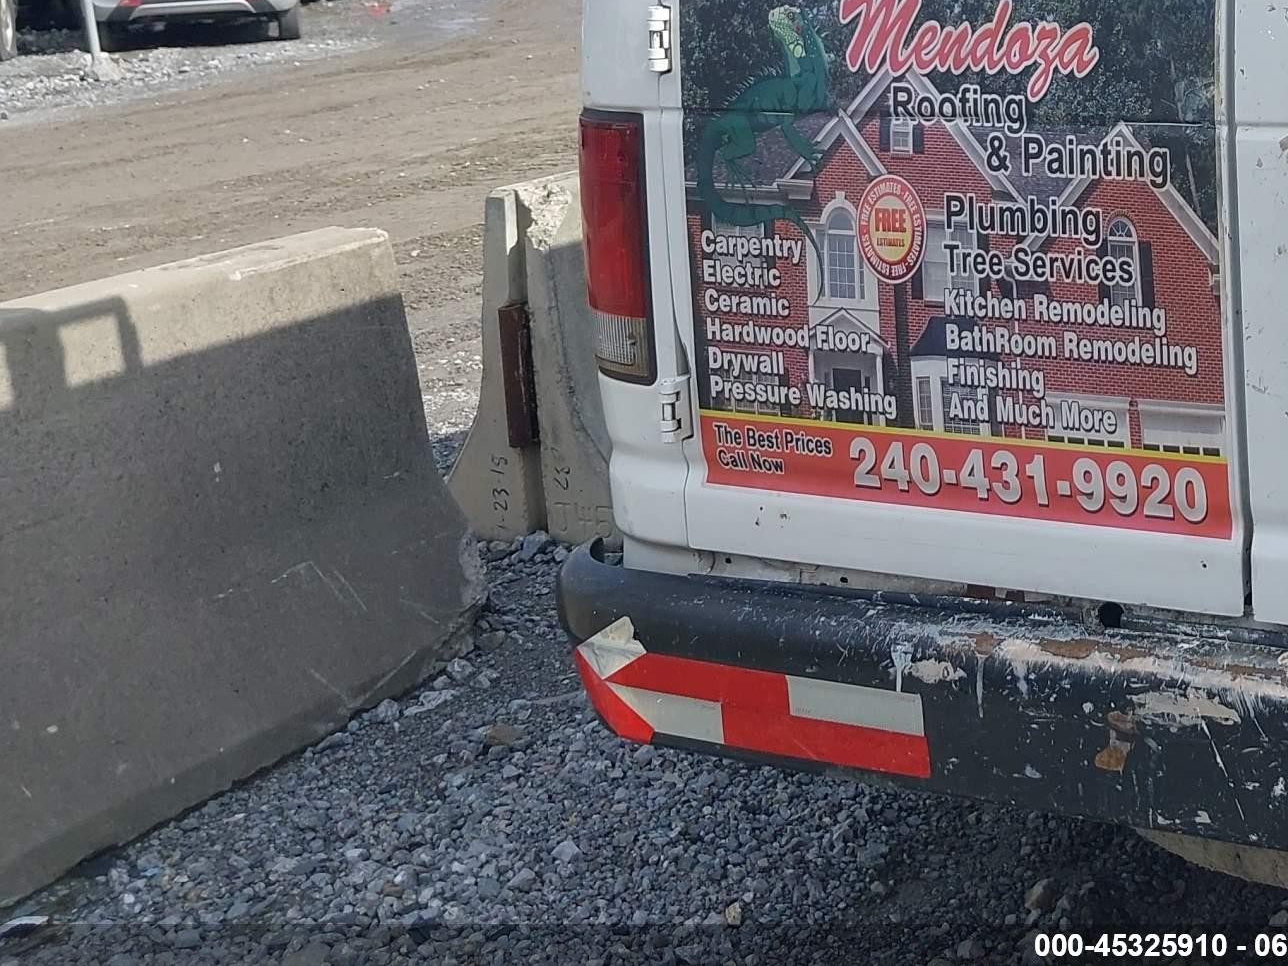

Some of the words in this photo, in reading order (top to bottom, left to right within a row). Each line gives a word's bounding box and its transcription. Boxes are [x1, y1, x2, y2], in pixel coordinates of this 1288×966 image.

[891, 84, 1026, 133] Roofing
[984, 135, 1012, 172] &
[1022, 135, 1170, 188] Painting
[874, 207, 907, 233] FREE
[944, 194, 1103, 246] Plumbing
[701, 230, 802, 263] Carpentry
[943, 242, 1004, 278] Tree
[1011, 248, 1136, 286] Services
[702, 260, 782, 287] Electric
[704, 288, 790, 317] Ceramic
[943, 288, 1028, 321] Kitchen
[1033, 294, 1166, 335] Remodeling
[706, 319, 810, 348] Hardwood
[815, 327, 871, 353] Floor
[944, 324, 1058, 359] BathRoom
[1063, 332, 1198, 375] Remodeling
[708, 346, 785, 376] Drywall
[945, 357, 1046, 398] Finishing
[709, 376, 801, 406] Pressure
[806, 385, 898, 420] Washing
[949, 392, 990, 424] And
[995, 397, 1055, 430] Much
[1060, 401, 1117, 434] More
[713, 422, 743, 447] The
[747, 427, 781, 452] Best
[783, 432, 833, 457] Prices
[717, 449, 747, 470] Call
[750, 453, 785, 475] Now
[849, 437, 1208, 523] 240-431-9920
